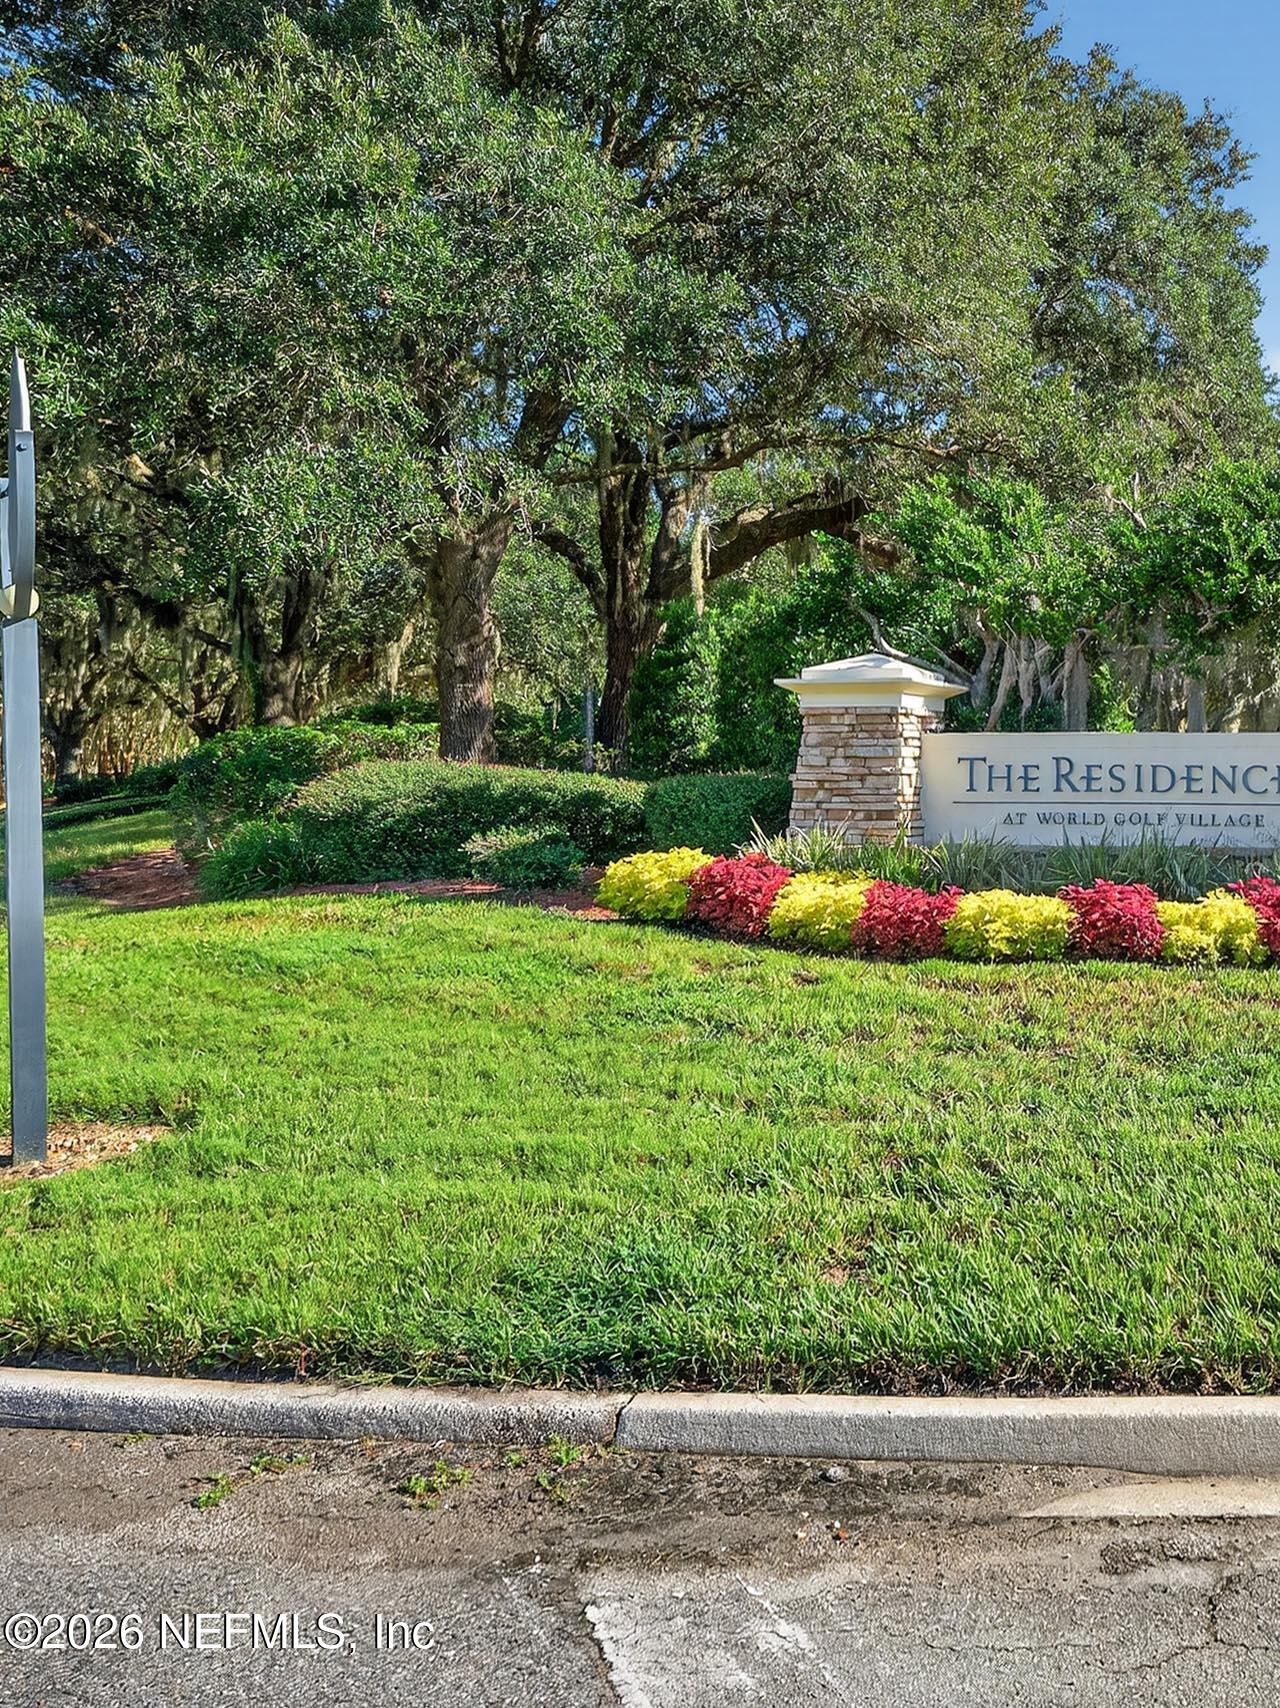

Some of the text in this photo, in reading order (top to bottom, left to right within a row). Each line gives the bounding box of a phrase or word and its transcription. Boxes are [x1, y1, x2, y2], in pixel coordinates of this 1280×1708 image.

[957, 756, 1041, 793] THE
[1002, 812, 1266, 828] AT WORLD GOLF VILLAGE
